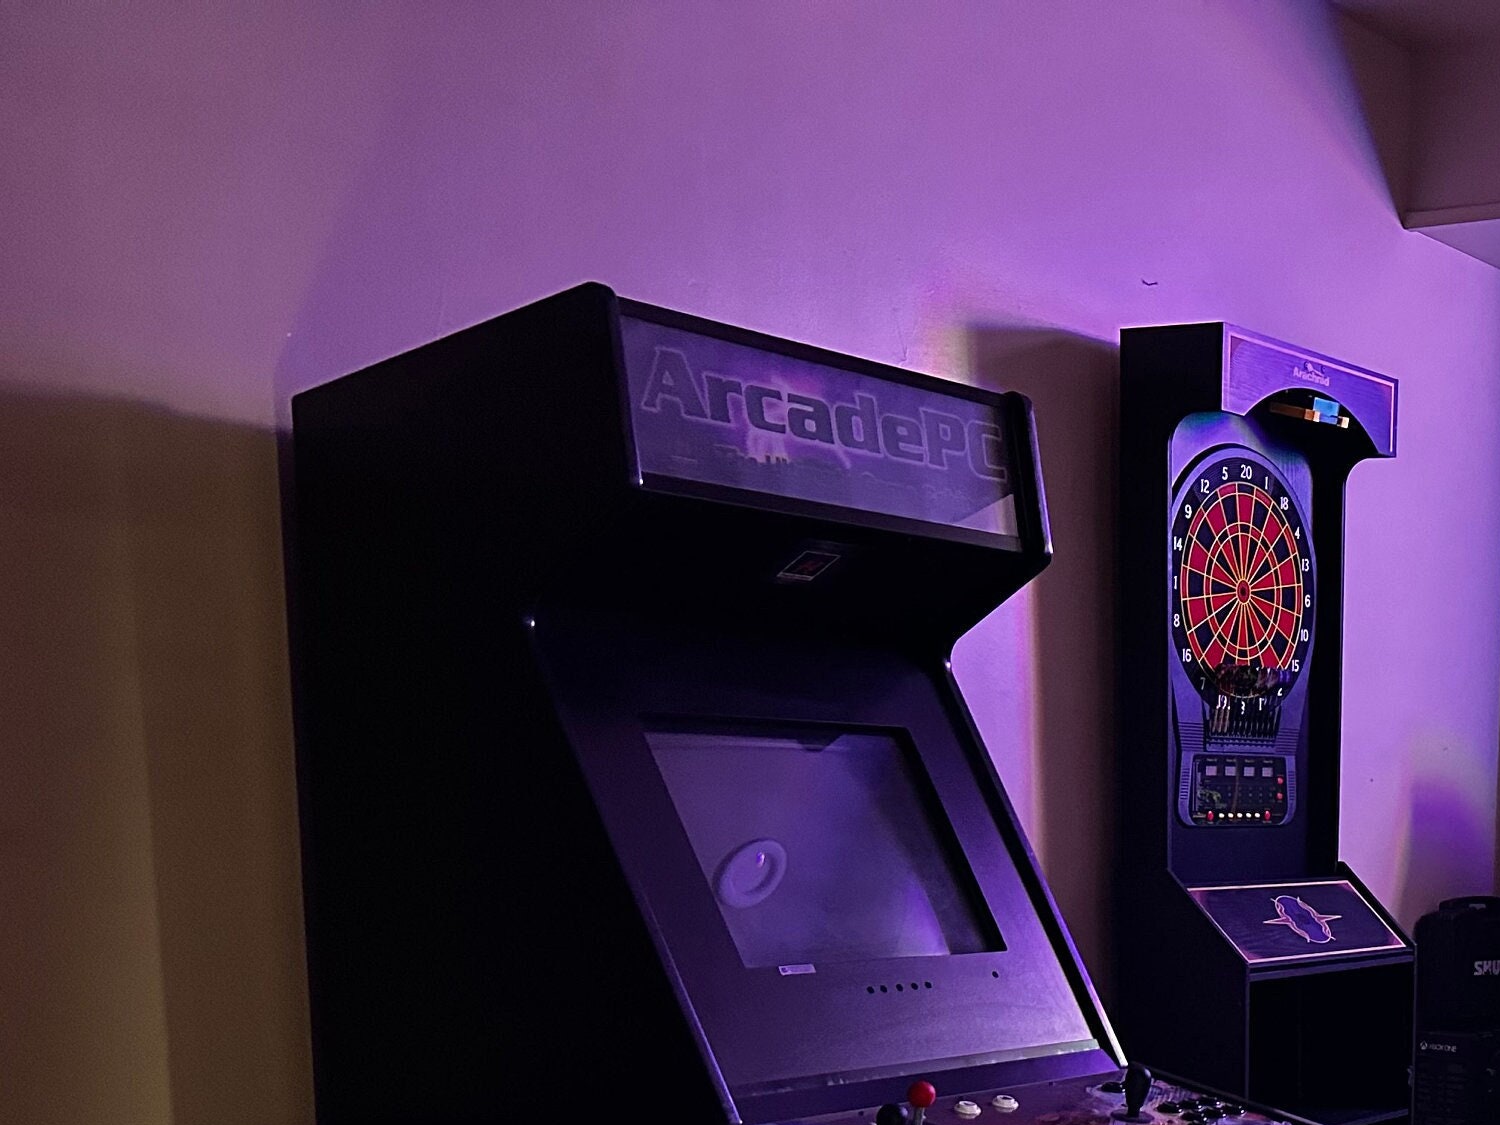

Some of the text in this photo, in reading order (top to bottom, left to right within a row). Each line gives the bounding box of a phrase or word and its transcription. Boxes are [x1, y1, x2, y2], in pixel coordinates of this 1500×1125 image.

[641, 346, 1008, 483] ArcadePC
[1221, 466, 1229, 481] 5
[1240, 464, 1253, 480] 20
[1200, 478, 1210, 494] 12
[1264, 476, 1269, 490] 1
[1280, 496, 1289, 511] 18
[1184, 504, 1193, 519] 9
[1294, 526, 1301, 540] 4
[1173, 536, 1183, 551] 14
[1301, 558, 1310, 572] 13
[1304, 594, 1311, 608] 6
[1173, 613, 1180, 627] 8
[1300, 629, 1309, 642] 10
[1182, 648, 1192, 662] 16
[1291, 659, 1300, 672] 15
[1200, 676, 1206, 691] 7
